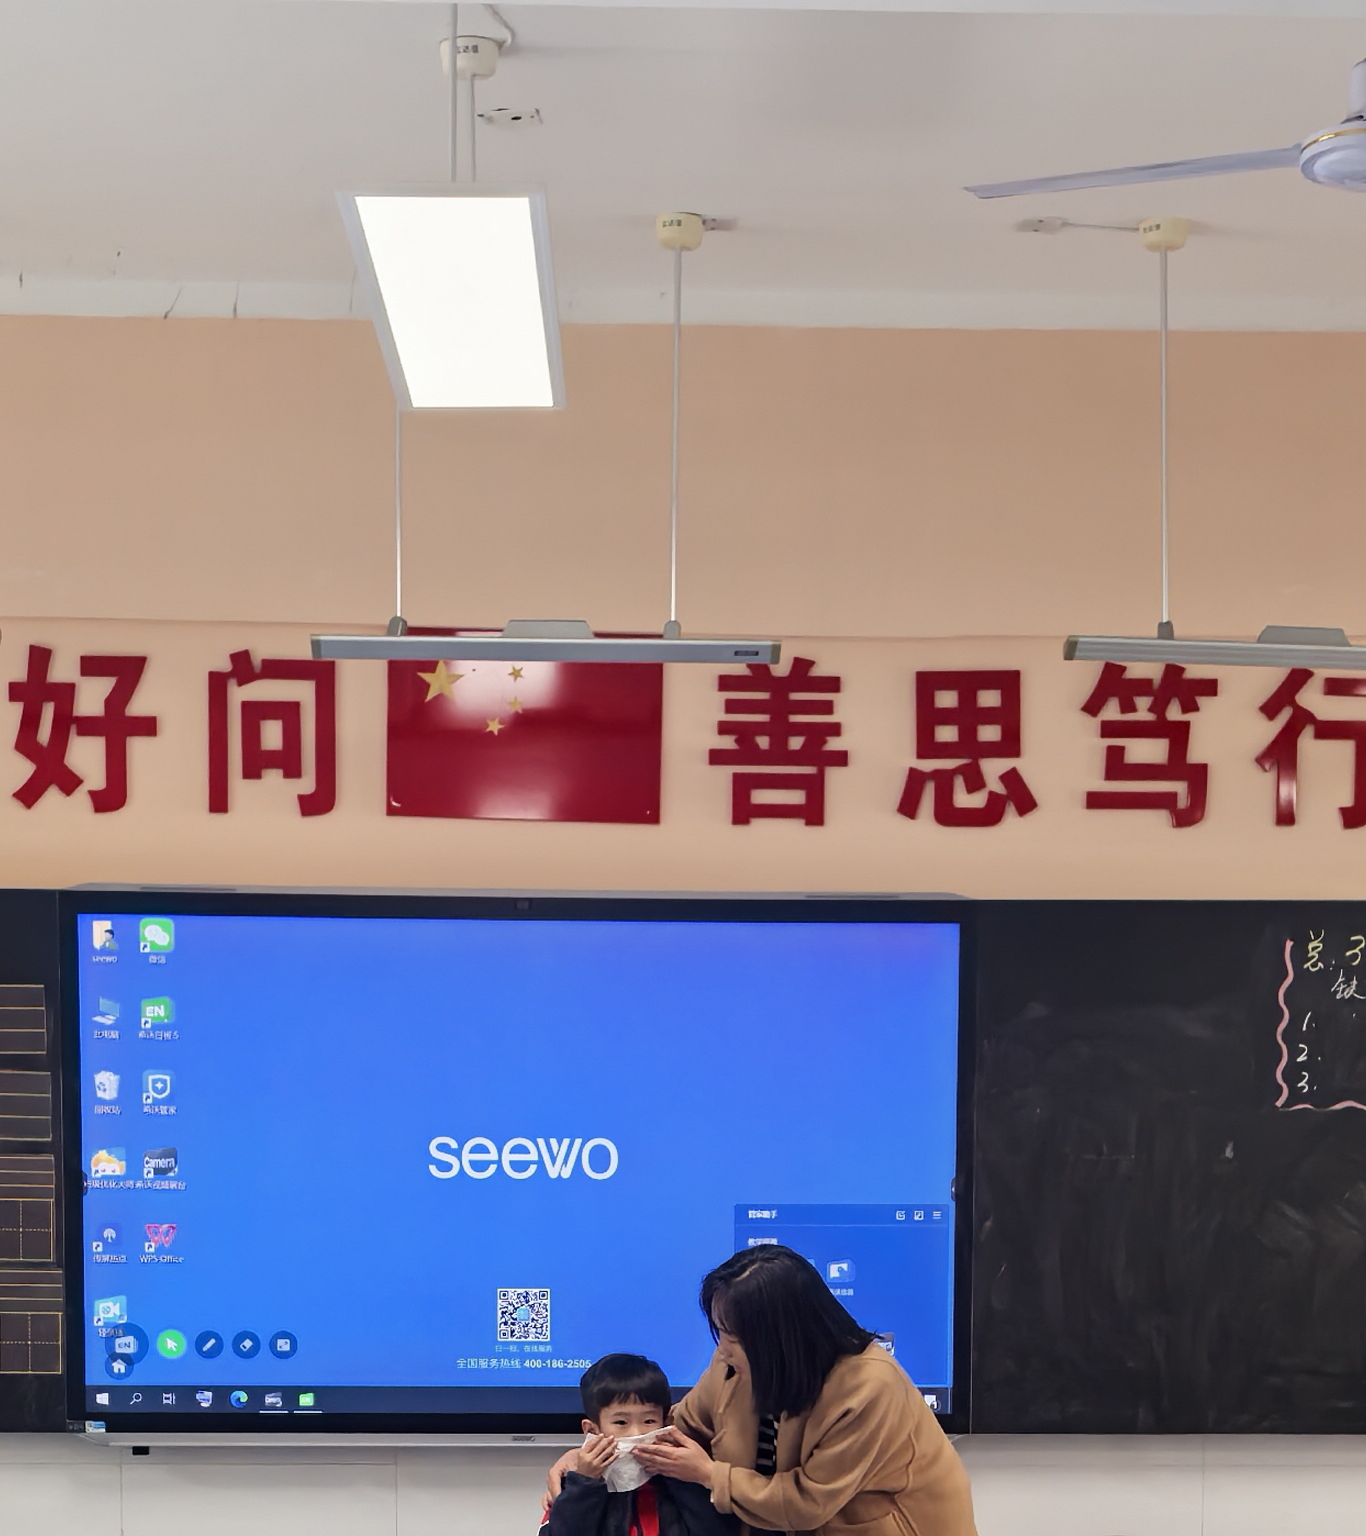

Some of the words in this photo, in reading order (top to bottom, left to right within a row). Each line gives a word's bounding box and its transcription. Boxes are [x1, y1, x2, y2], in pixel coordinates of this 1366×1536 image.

[146, 1005, 165, 1017] EN
[144, 1157, 176, 1169] Camera
[428, 1136, 619, 1181] seewo
[456, 1358, 521, 1369] 全国服务热线
